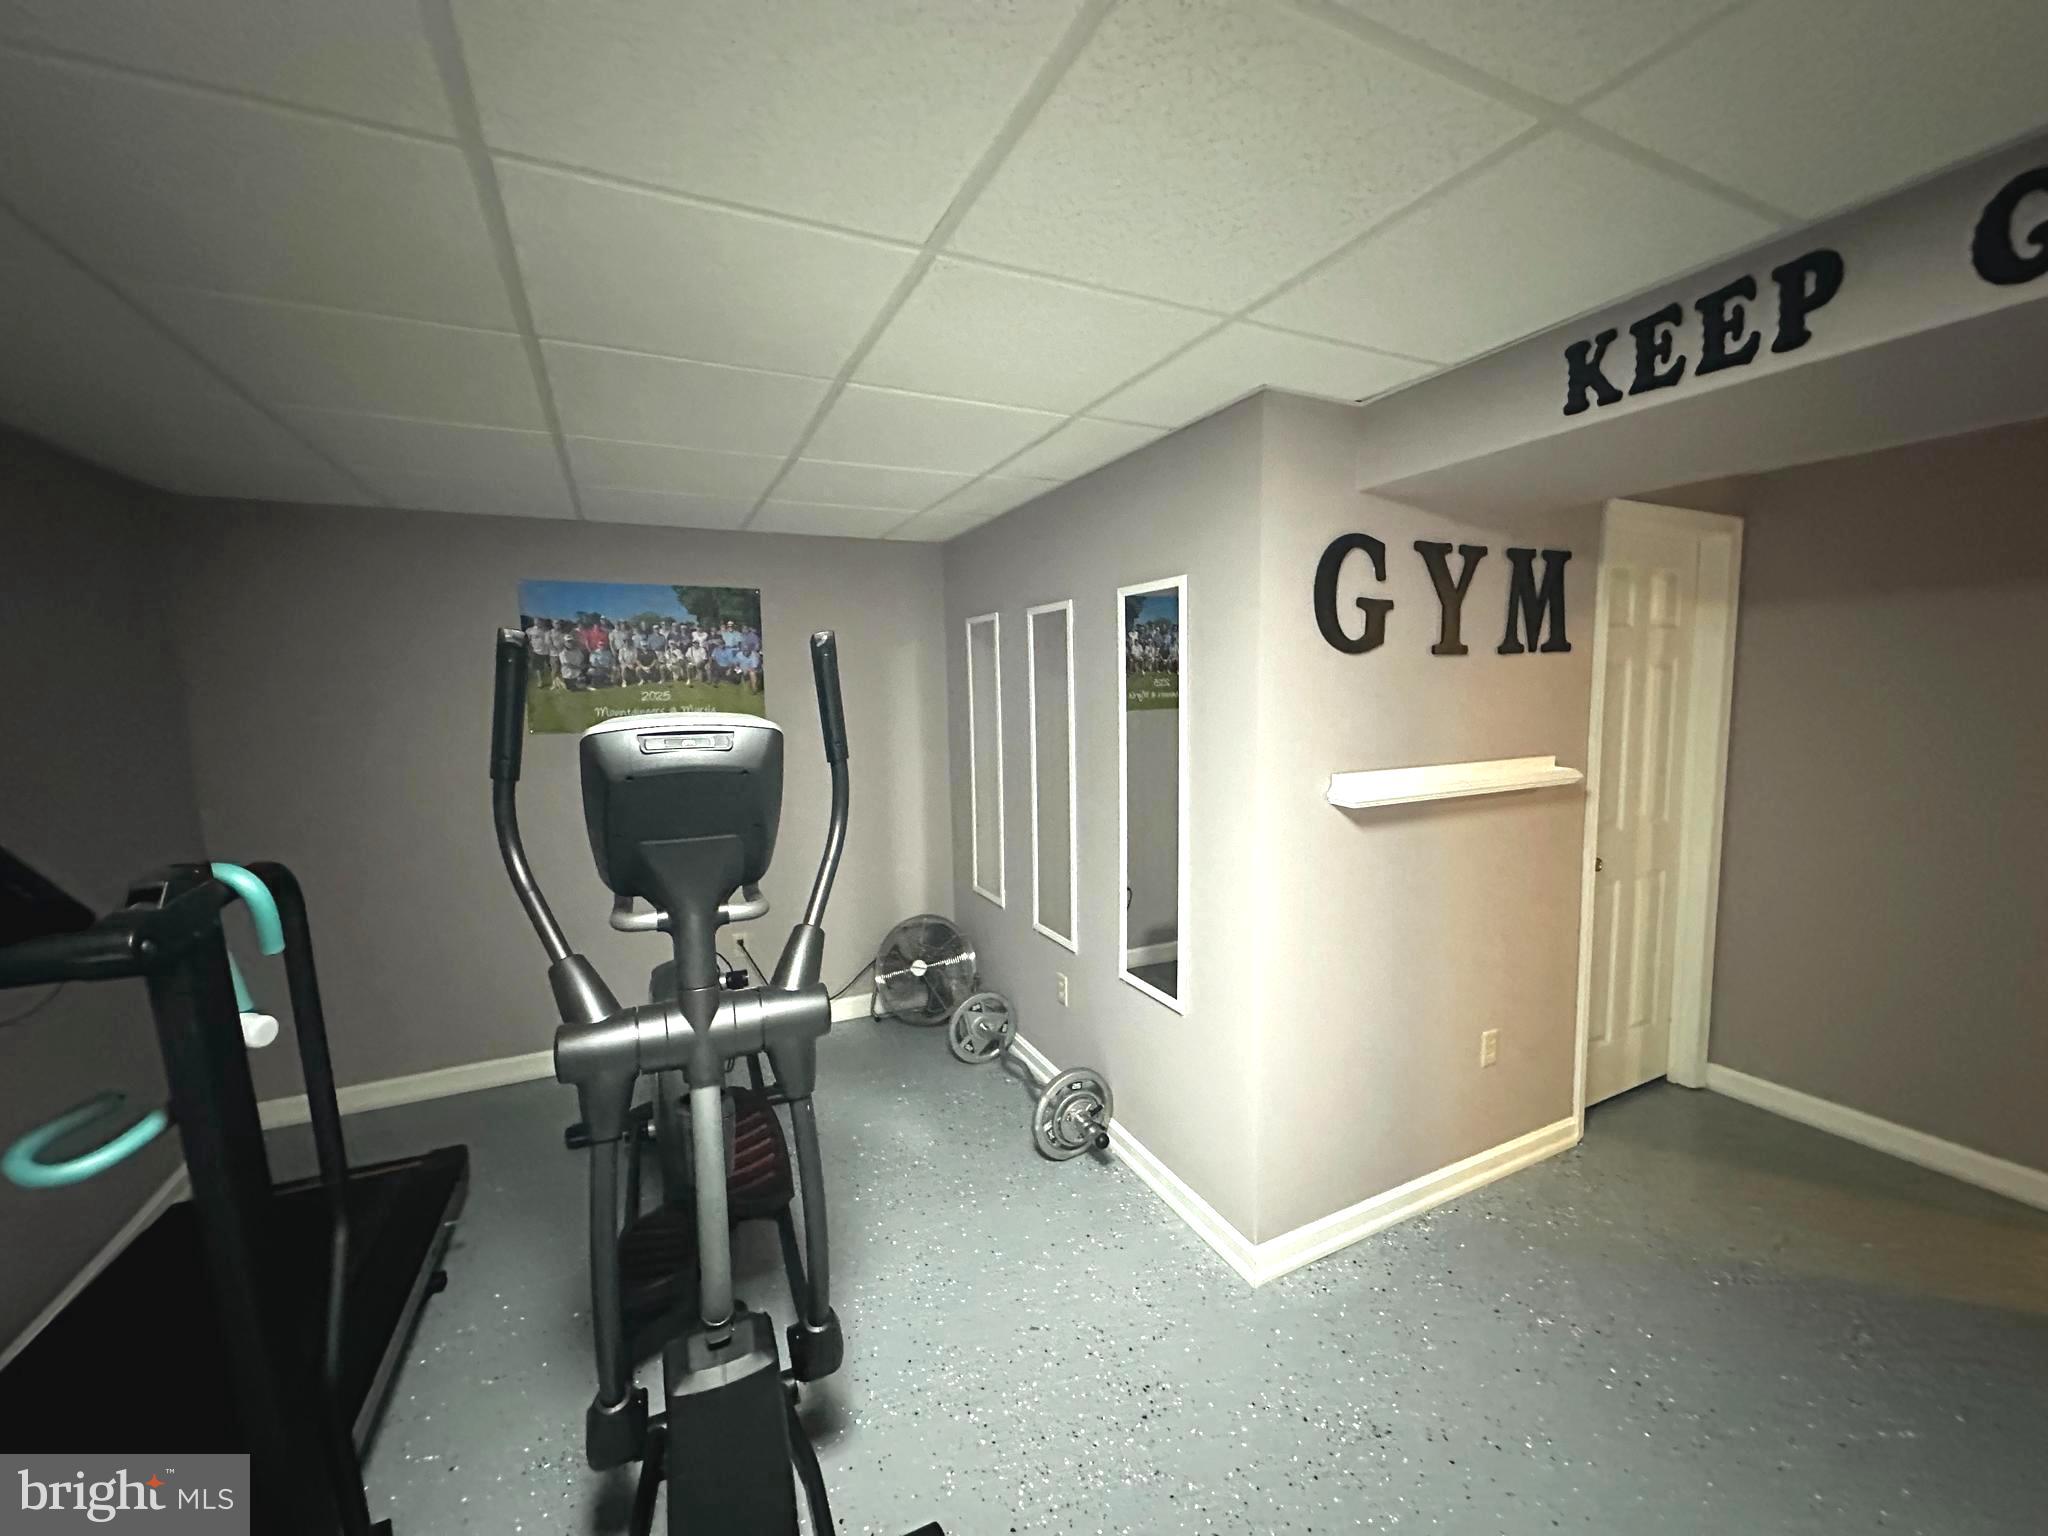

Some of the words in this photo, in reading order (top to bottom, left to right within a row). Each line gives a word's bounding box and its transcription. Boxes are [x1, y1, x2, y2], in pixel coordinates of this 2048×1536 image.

[1562, 249, 1845, 416] KEEP
[1313, 533, 1572, 655] GYM
[641, 690, 672, 702] 2025
